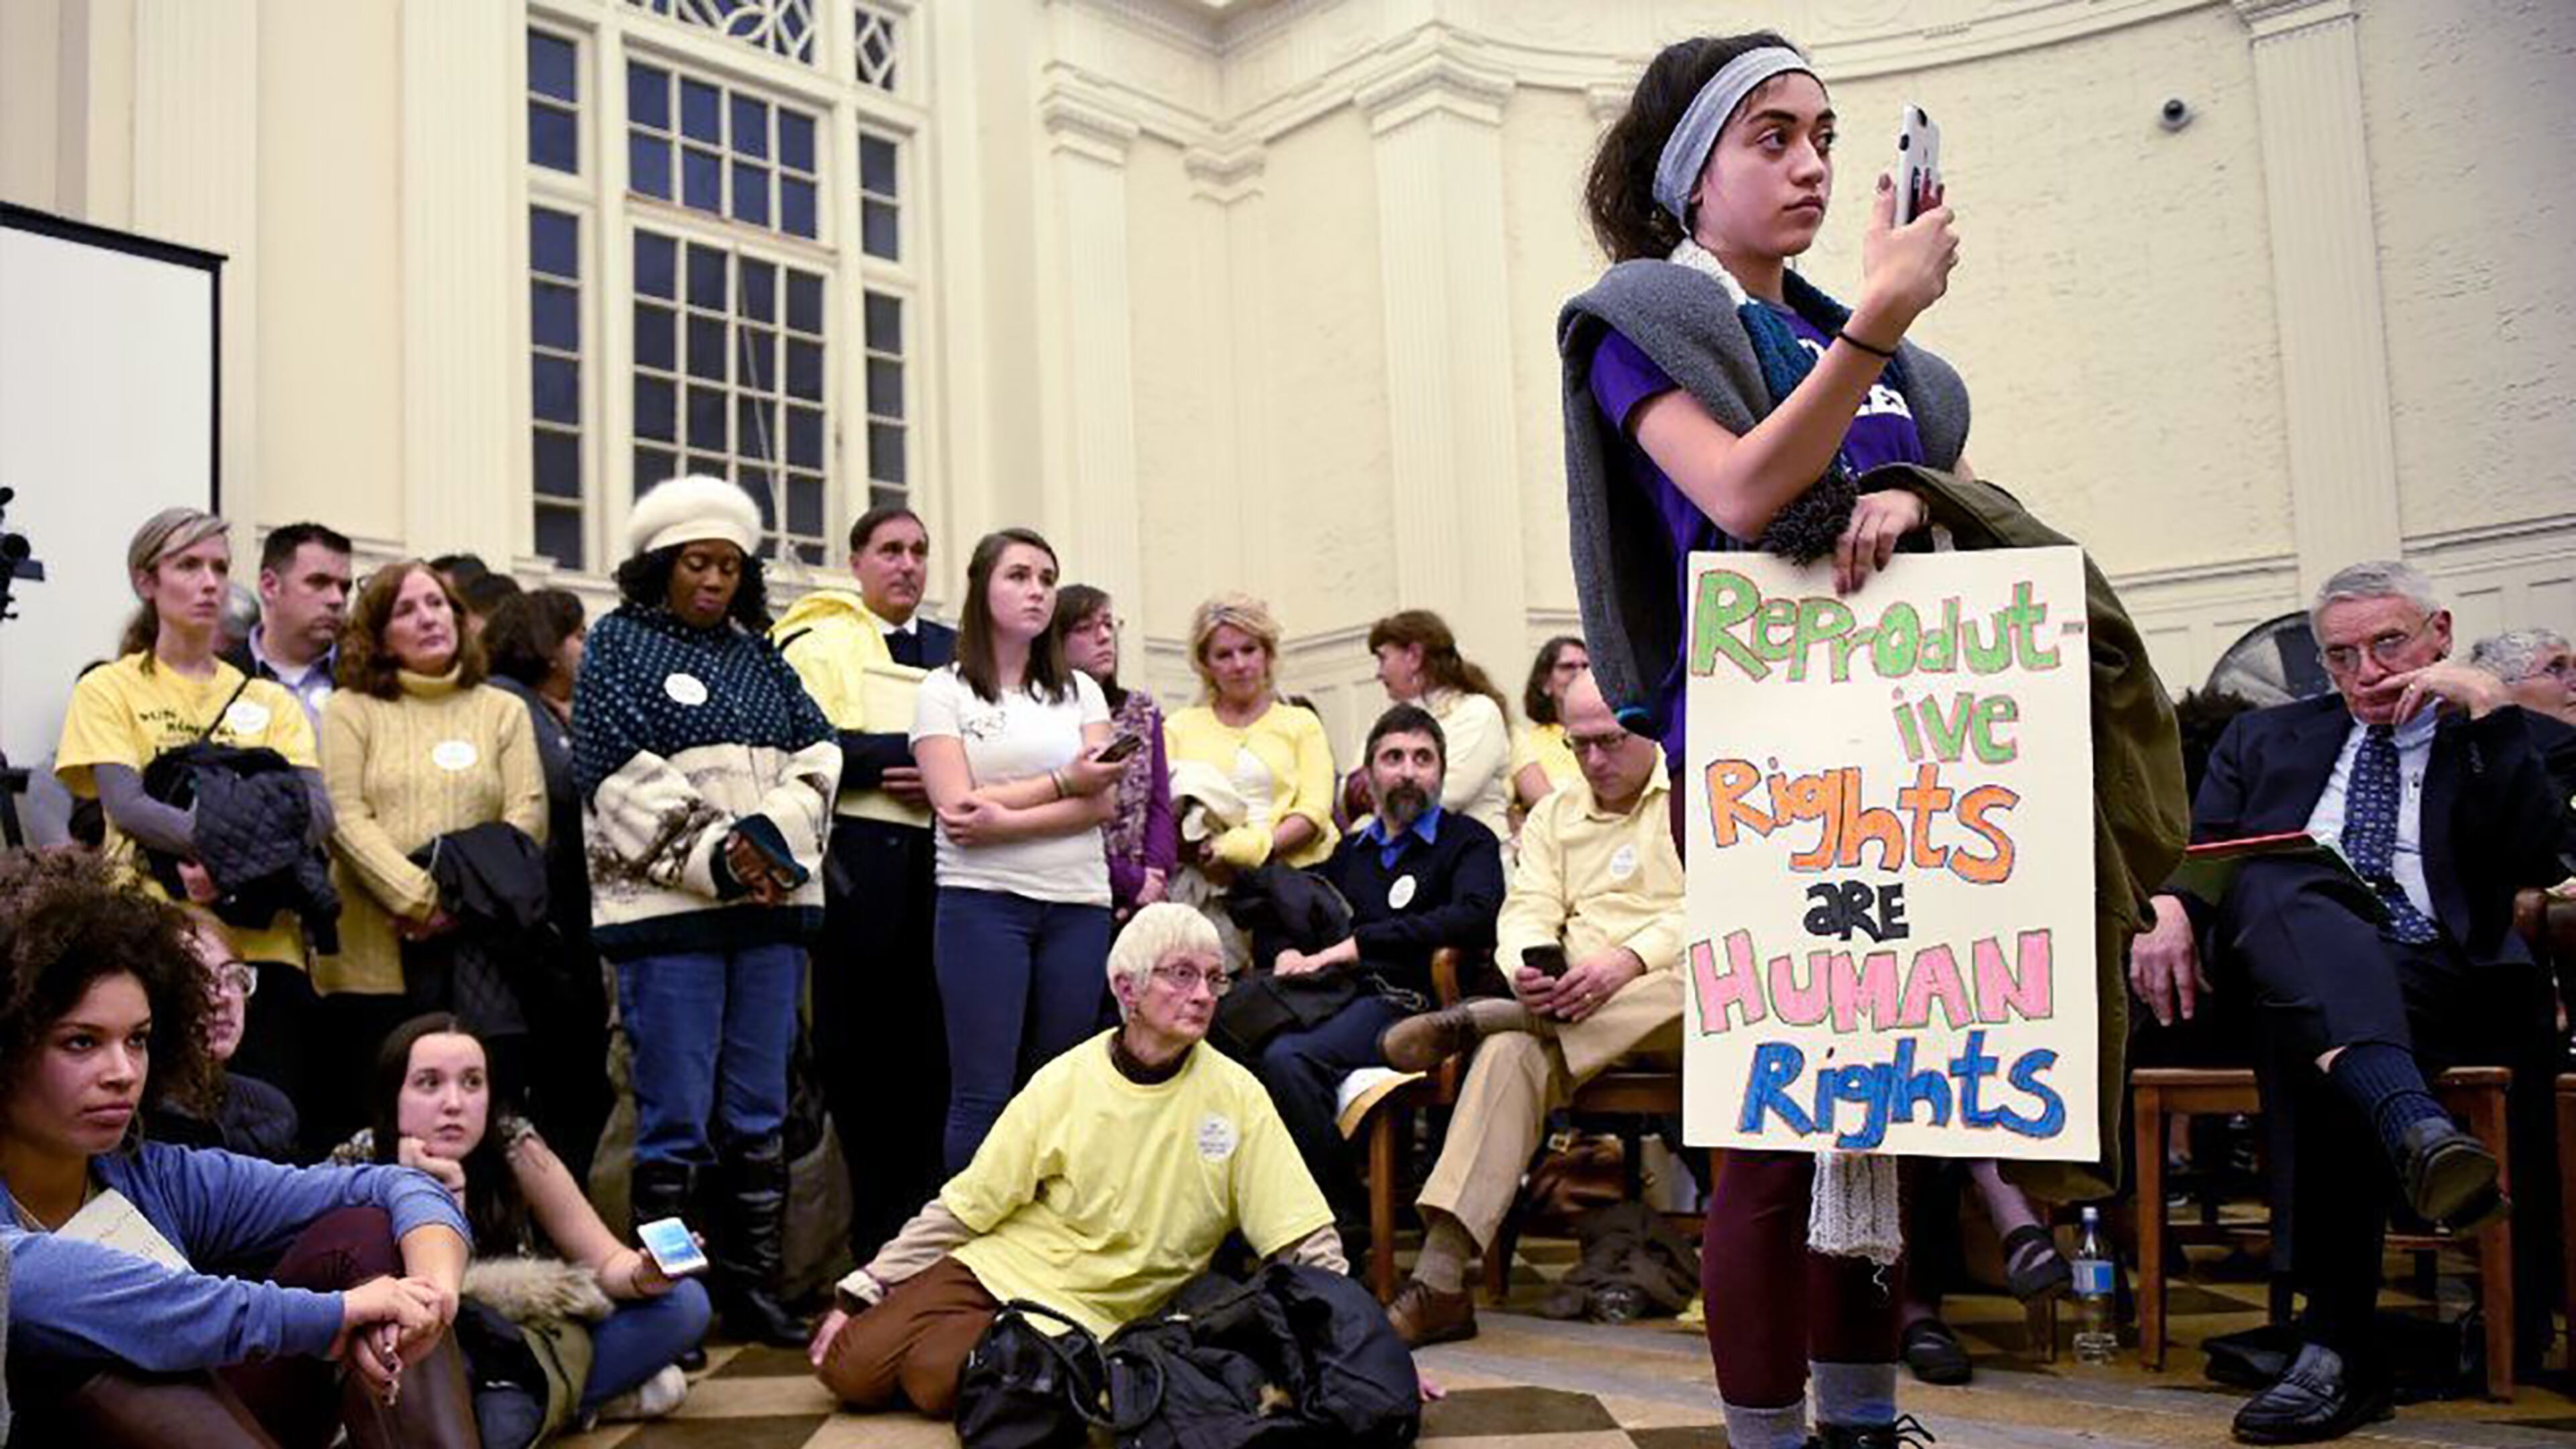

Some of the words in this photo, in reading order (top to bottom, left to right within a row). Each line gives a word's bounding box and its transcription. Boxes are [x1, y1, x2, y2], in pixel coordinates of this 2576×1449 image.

[1892, 688, 2019, 764] ive
[1706, 756, 2021, 885] Rights
[1690, 928, 2053, 1035] HUMAN
[1737, 1029, 2066, 1150] Rights
